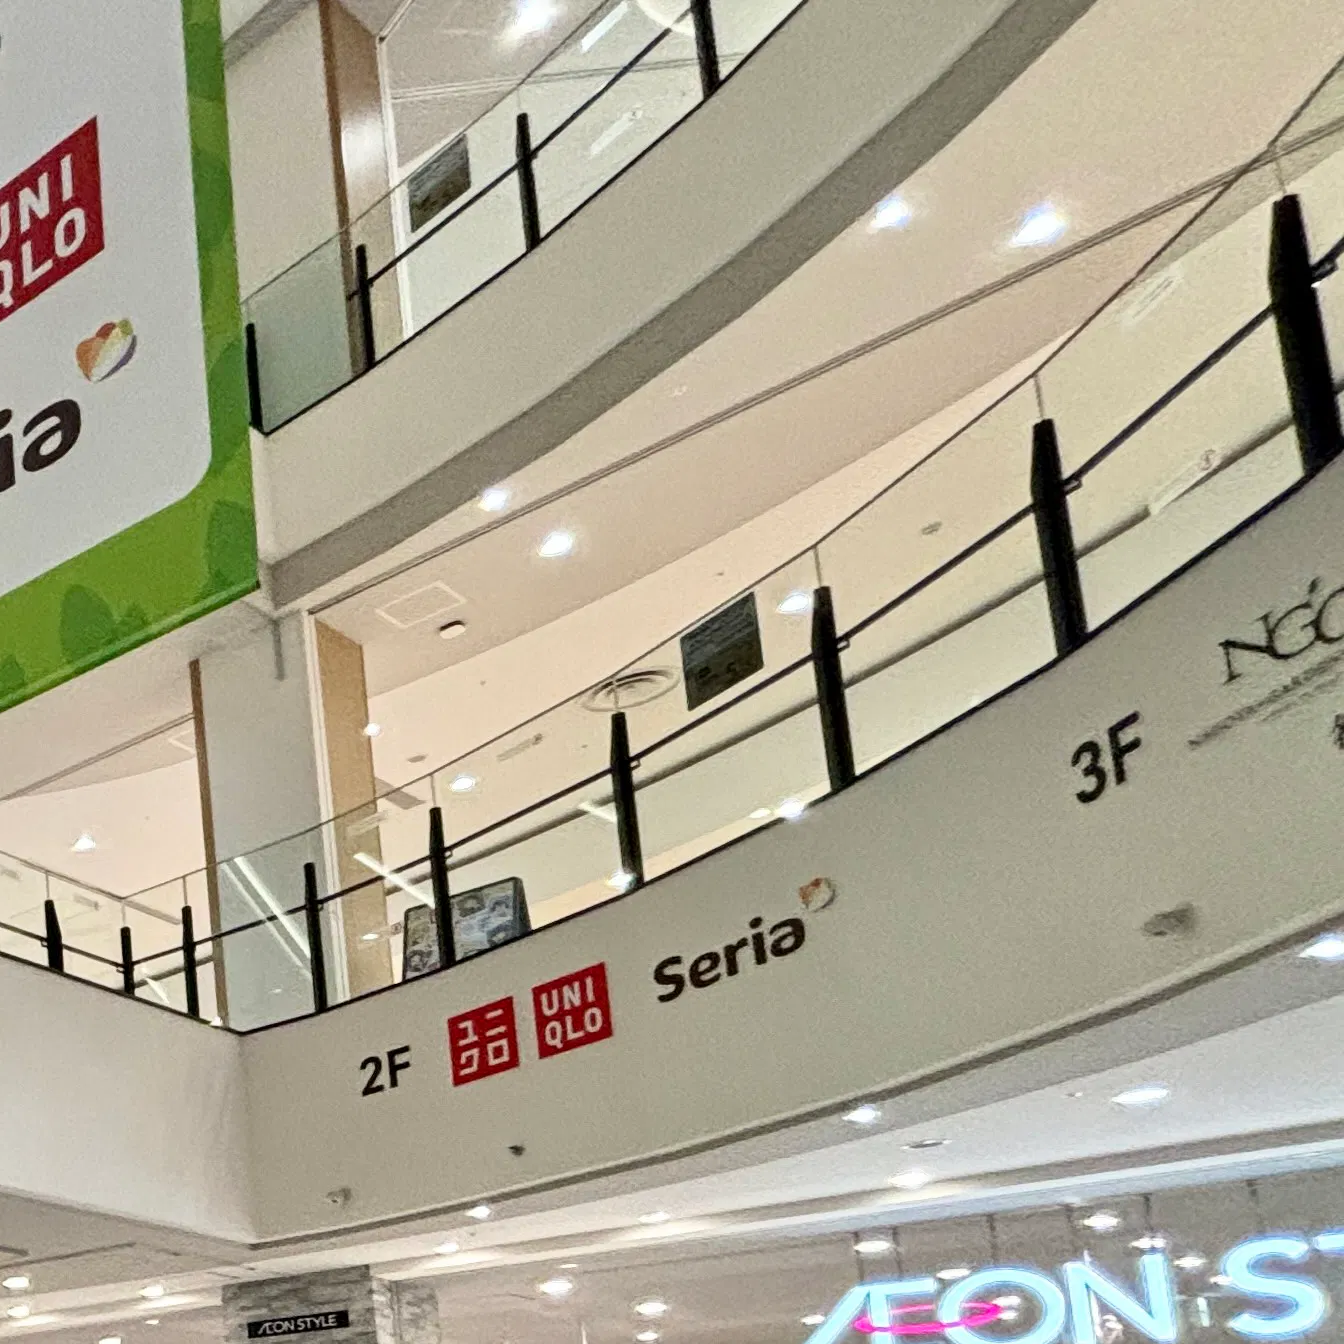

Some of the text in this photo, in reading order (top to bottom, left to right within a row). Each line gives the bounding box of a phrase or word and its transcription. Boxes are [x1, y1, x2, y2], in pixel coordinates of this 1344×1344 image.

[1070, 710, 1142, 804] 3F
[653, 915, 806, 1004] Seria
[540, 976, 595, 1017] UNI
[456, 1008, 507, 1047] ユニ
[544, 1006, 604, 1050] QLO
[359, 1044, 412, 1098] 2F
[458, 1037, 511, 1077] クロ
[296, 1313, 338, 1331] STYLE
